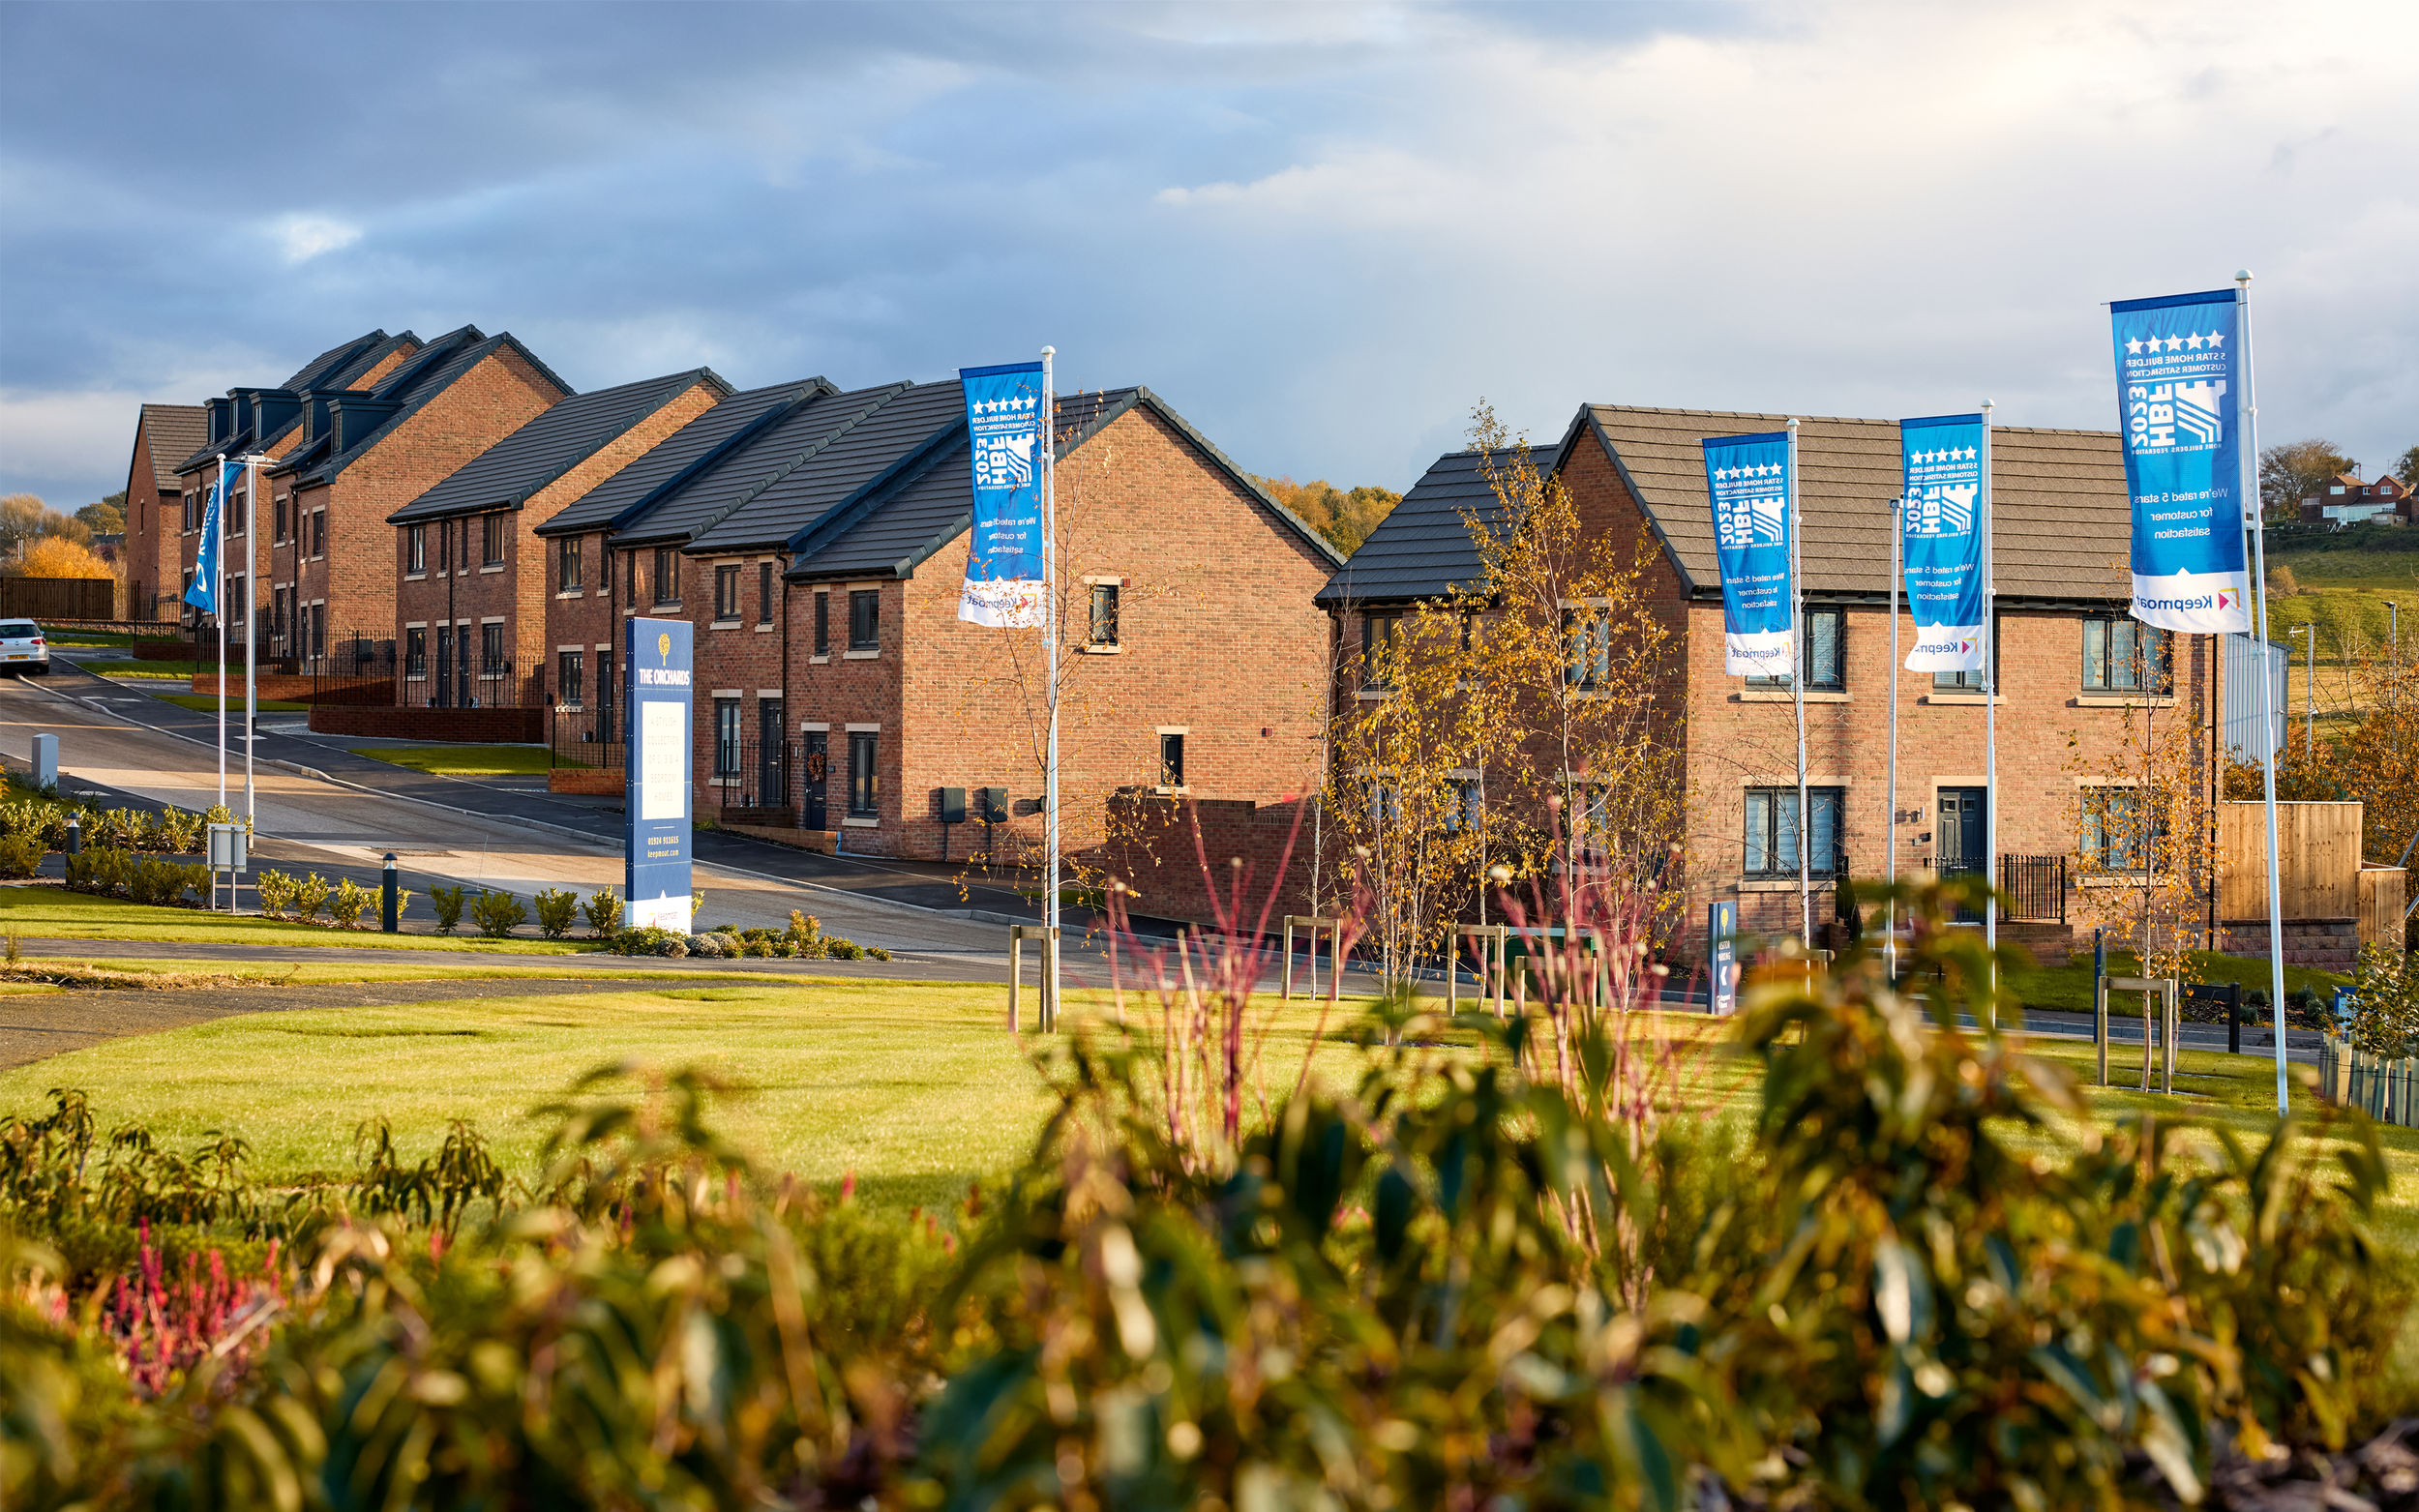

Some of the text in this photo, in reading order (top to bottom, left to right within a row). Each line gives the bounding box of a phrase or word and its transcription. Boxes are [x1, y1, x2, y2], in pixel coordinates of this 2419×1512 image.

[639, 667, 691, 686] THE ORCHARDS
[647, 735, 679, 746] COLLECTION
[647, 837, 662, 845] 01924
[647, 849, 679, 859] keepmoat.com
